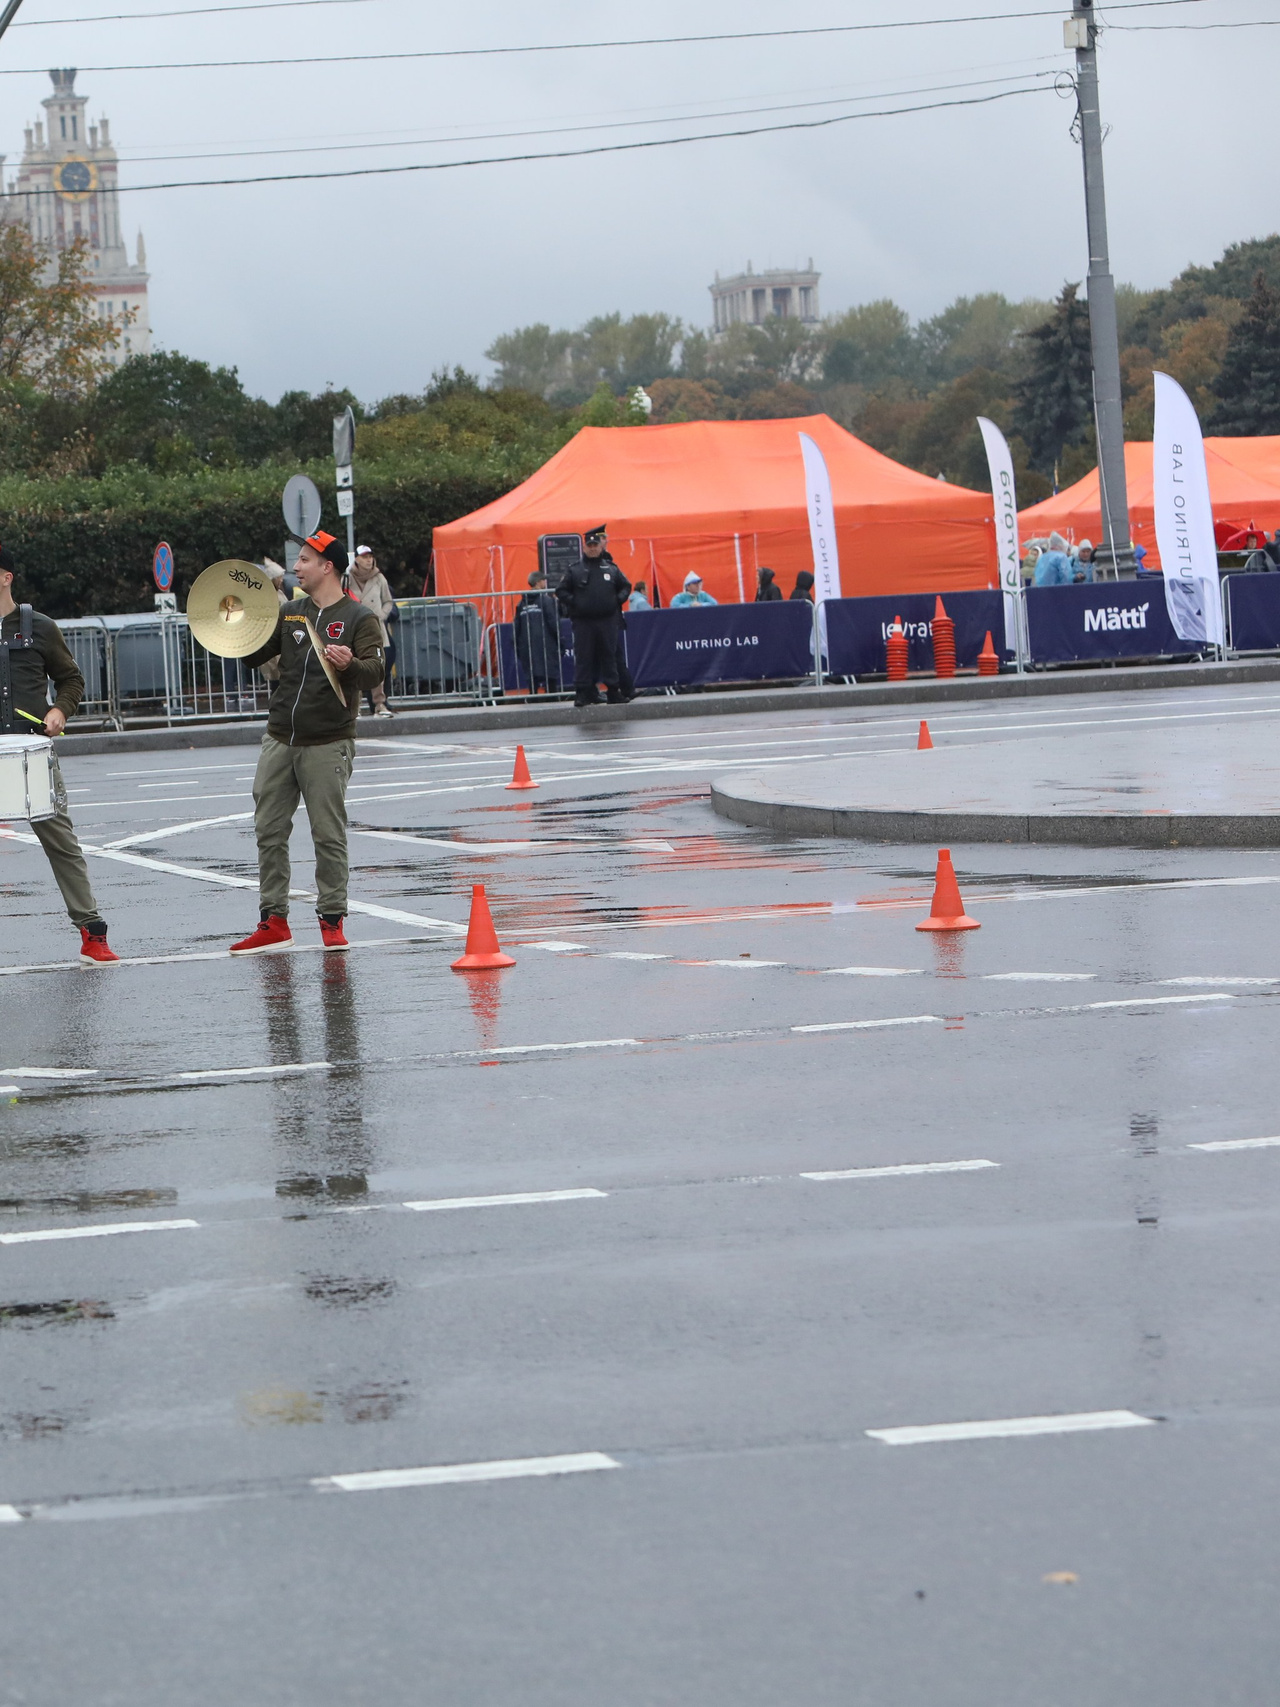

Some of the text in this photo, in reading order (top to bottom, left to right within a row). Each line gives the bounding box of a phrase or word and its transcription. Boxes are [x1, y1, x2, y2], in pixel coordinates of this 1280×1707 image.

[1084, 601, 1150, 632] Mätti
[675, 635, 759, 650] NUTRINO LAB
